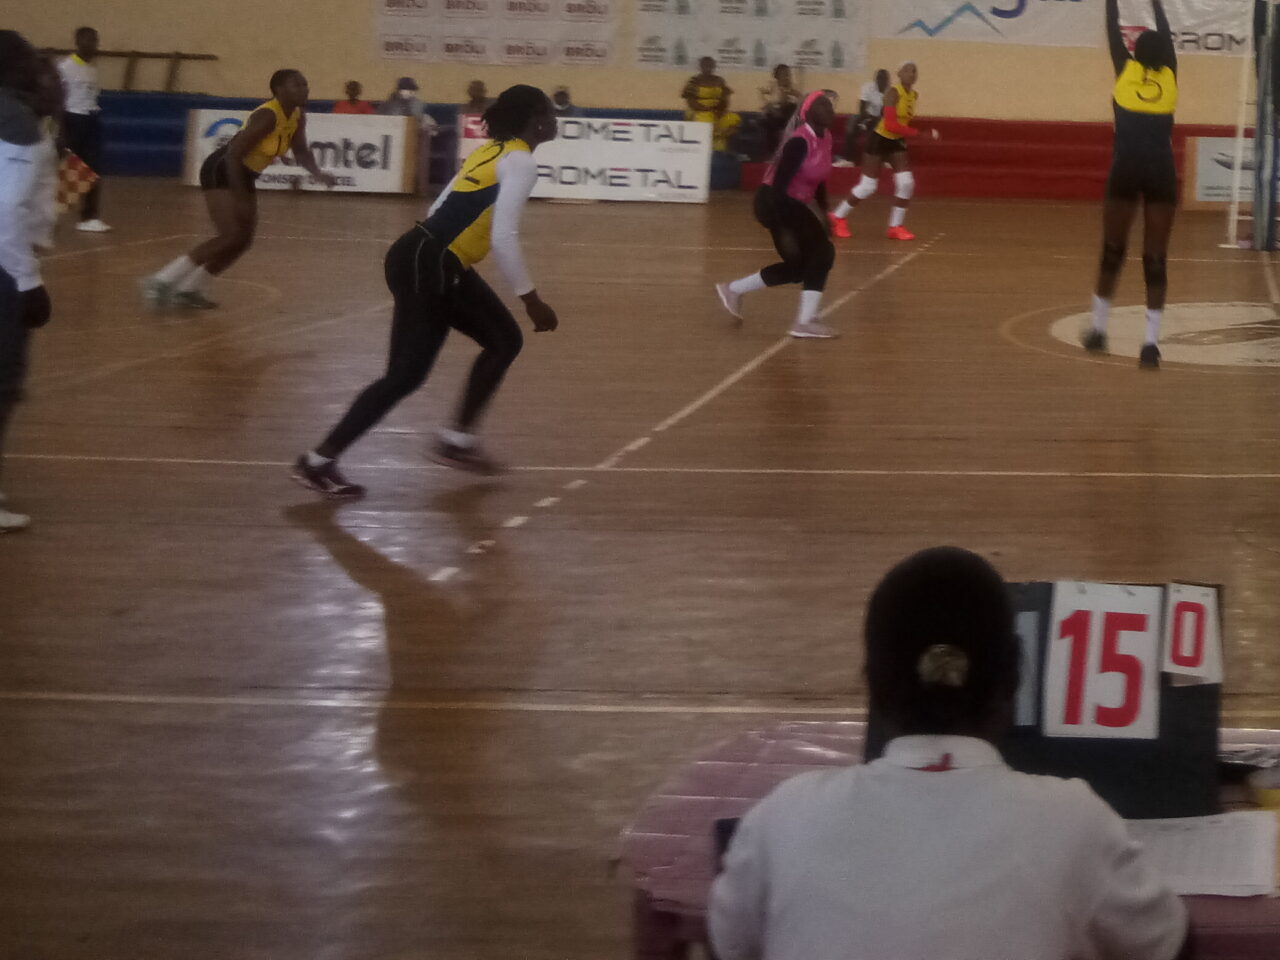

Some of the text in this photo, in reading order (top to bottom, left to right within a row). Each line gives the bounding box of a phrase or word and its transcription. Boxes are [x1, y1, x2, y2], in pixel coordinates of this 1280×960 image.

[536, 165, 699, 190] ROMETAL
[1057, 600, 1206, 729] 15 0
